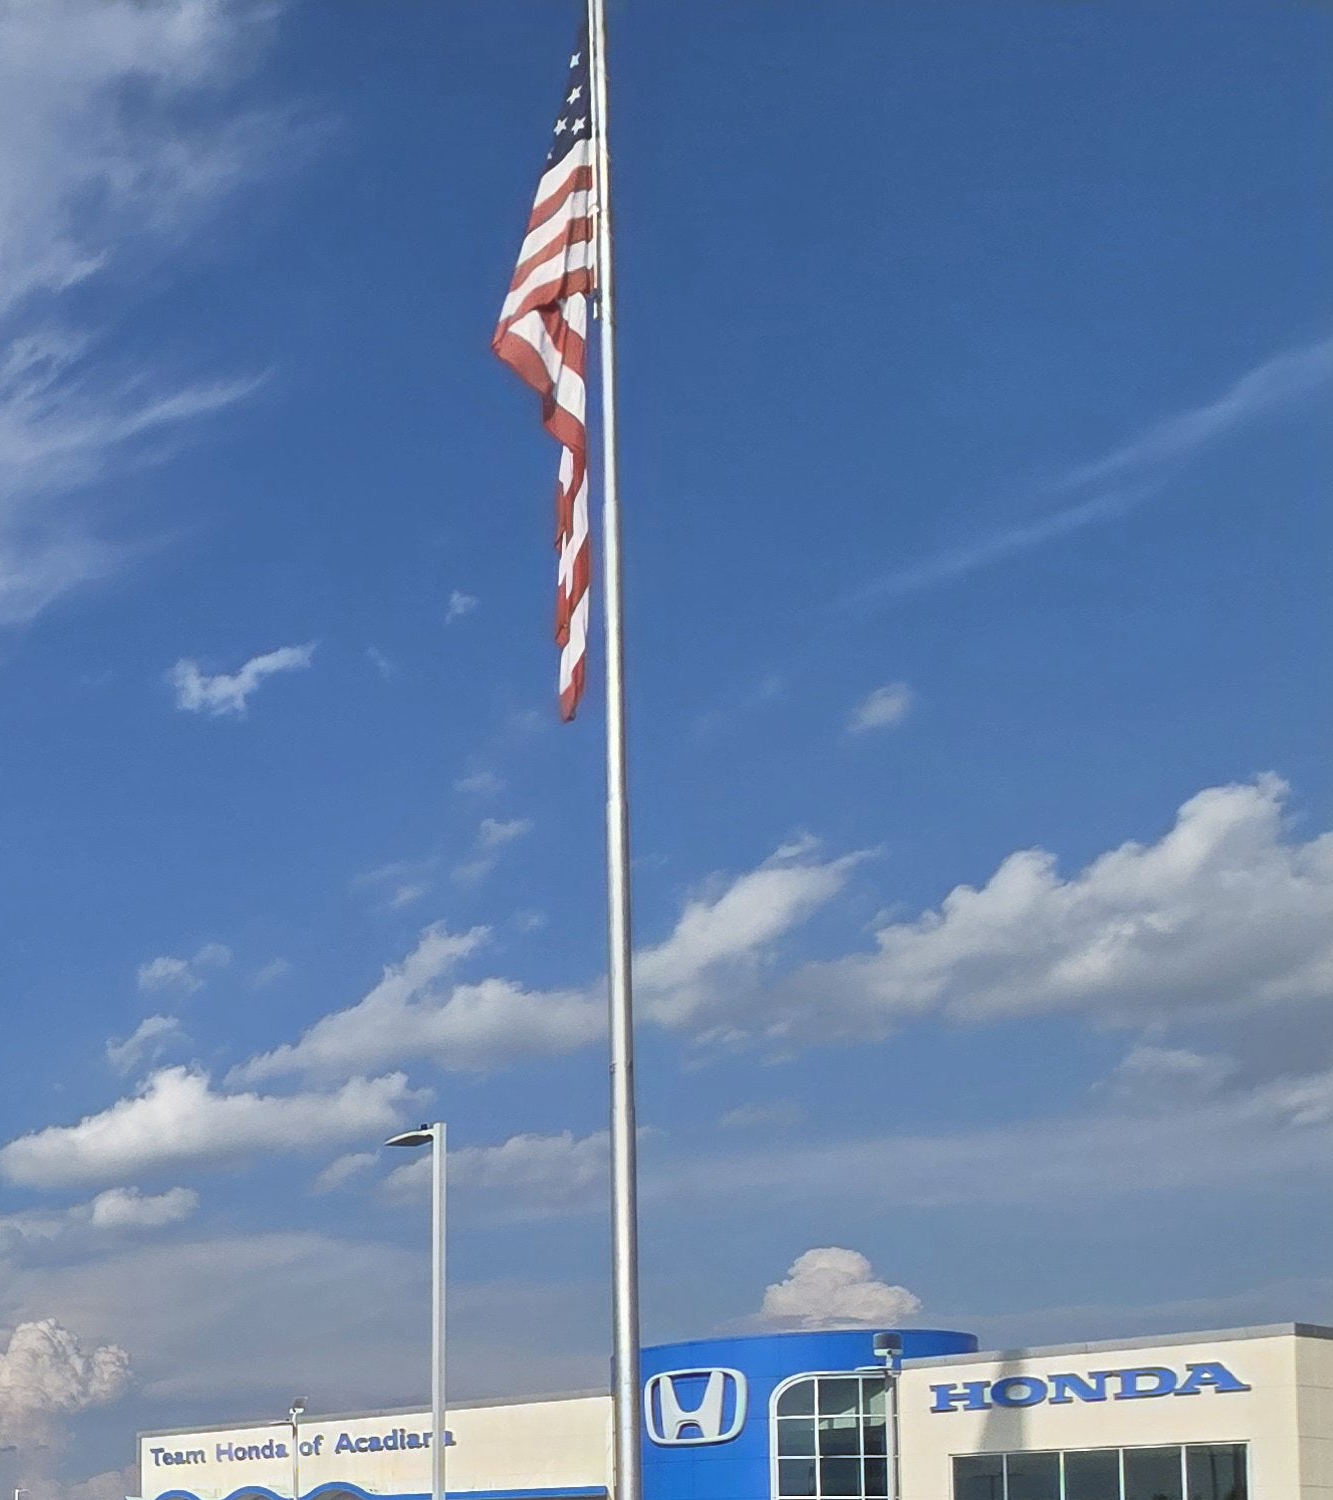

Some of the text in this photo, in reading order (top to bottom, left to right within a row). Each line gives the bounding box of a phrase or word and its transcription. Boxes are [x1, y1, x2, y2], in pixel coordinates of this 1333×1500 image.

[930, 1361, 1252, 1413] HONDA
[150, 1447, 206, 1467] Team
[216, 1439, 290, 1463] Honda
[299, 1435, 324, 1457] of
